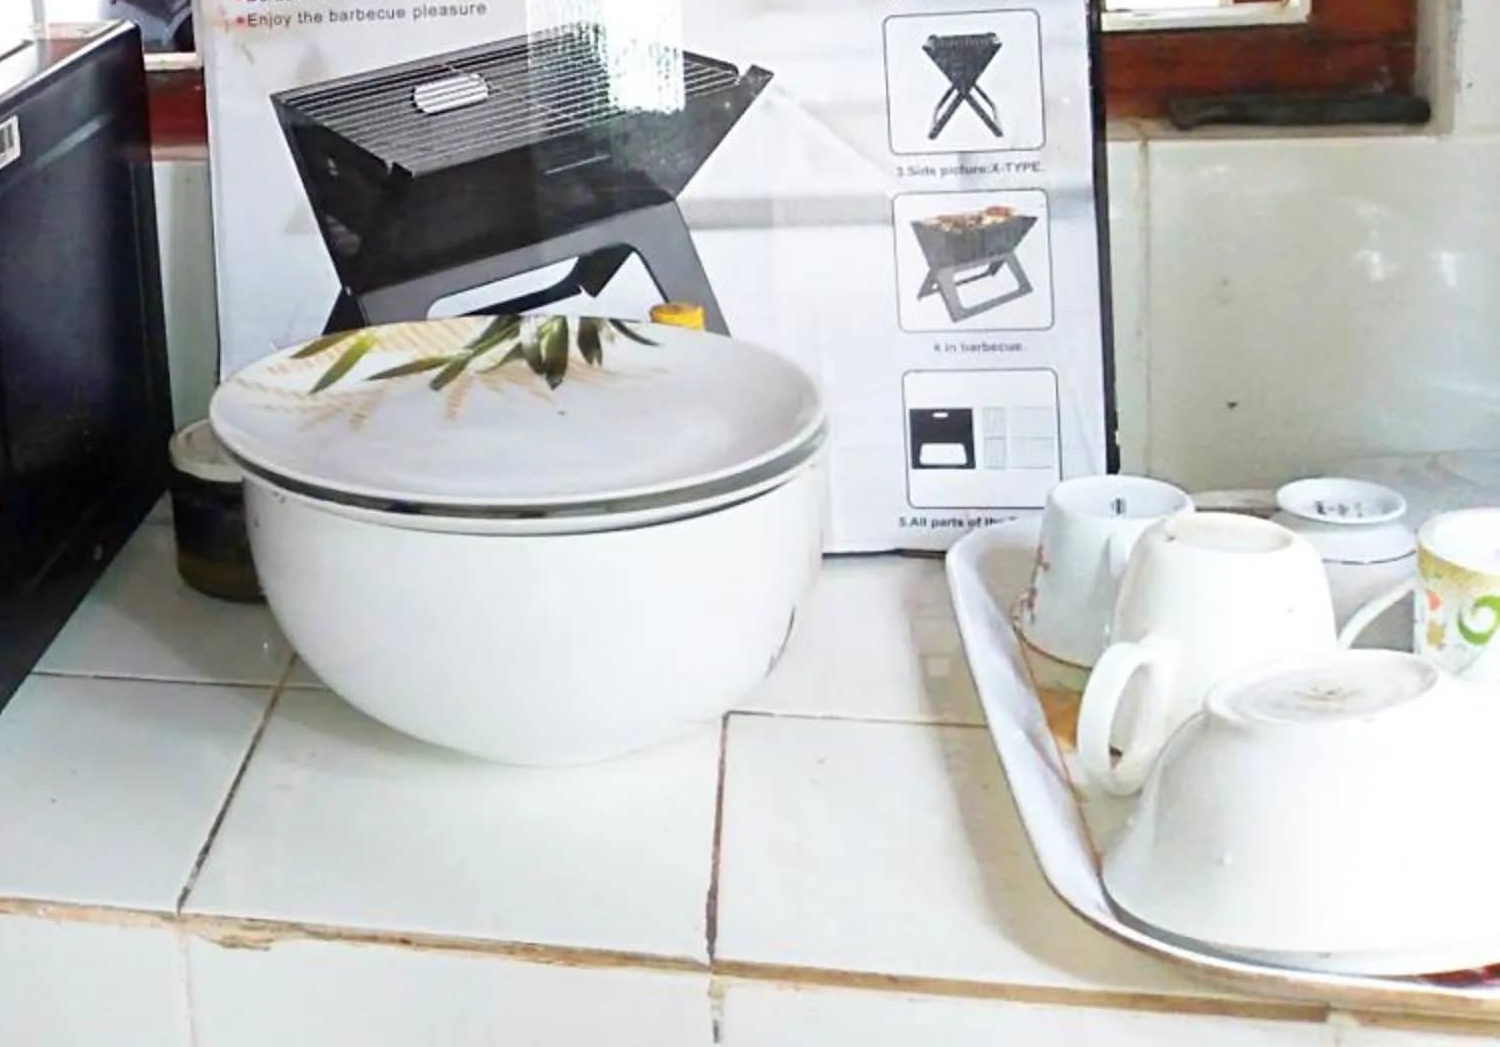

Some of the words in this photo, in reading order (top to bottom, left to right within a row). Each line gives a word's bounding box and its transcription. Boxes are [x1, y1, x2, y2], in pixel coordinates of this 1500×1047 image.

[247, 13, 292, 30] Enjoy
[297, 8, 323, 25] the
[329, 5, 407, 23] barbecue
[412, 2, 487, 22] pleasure
[931, 516, 964, 529] parts
[967, 516, 982, 528] of
